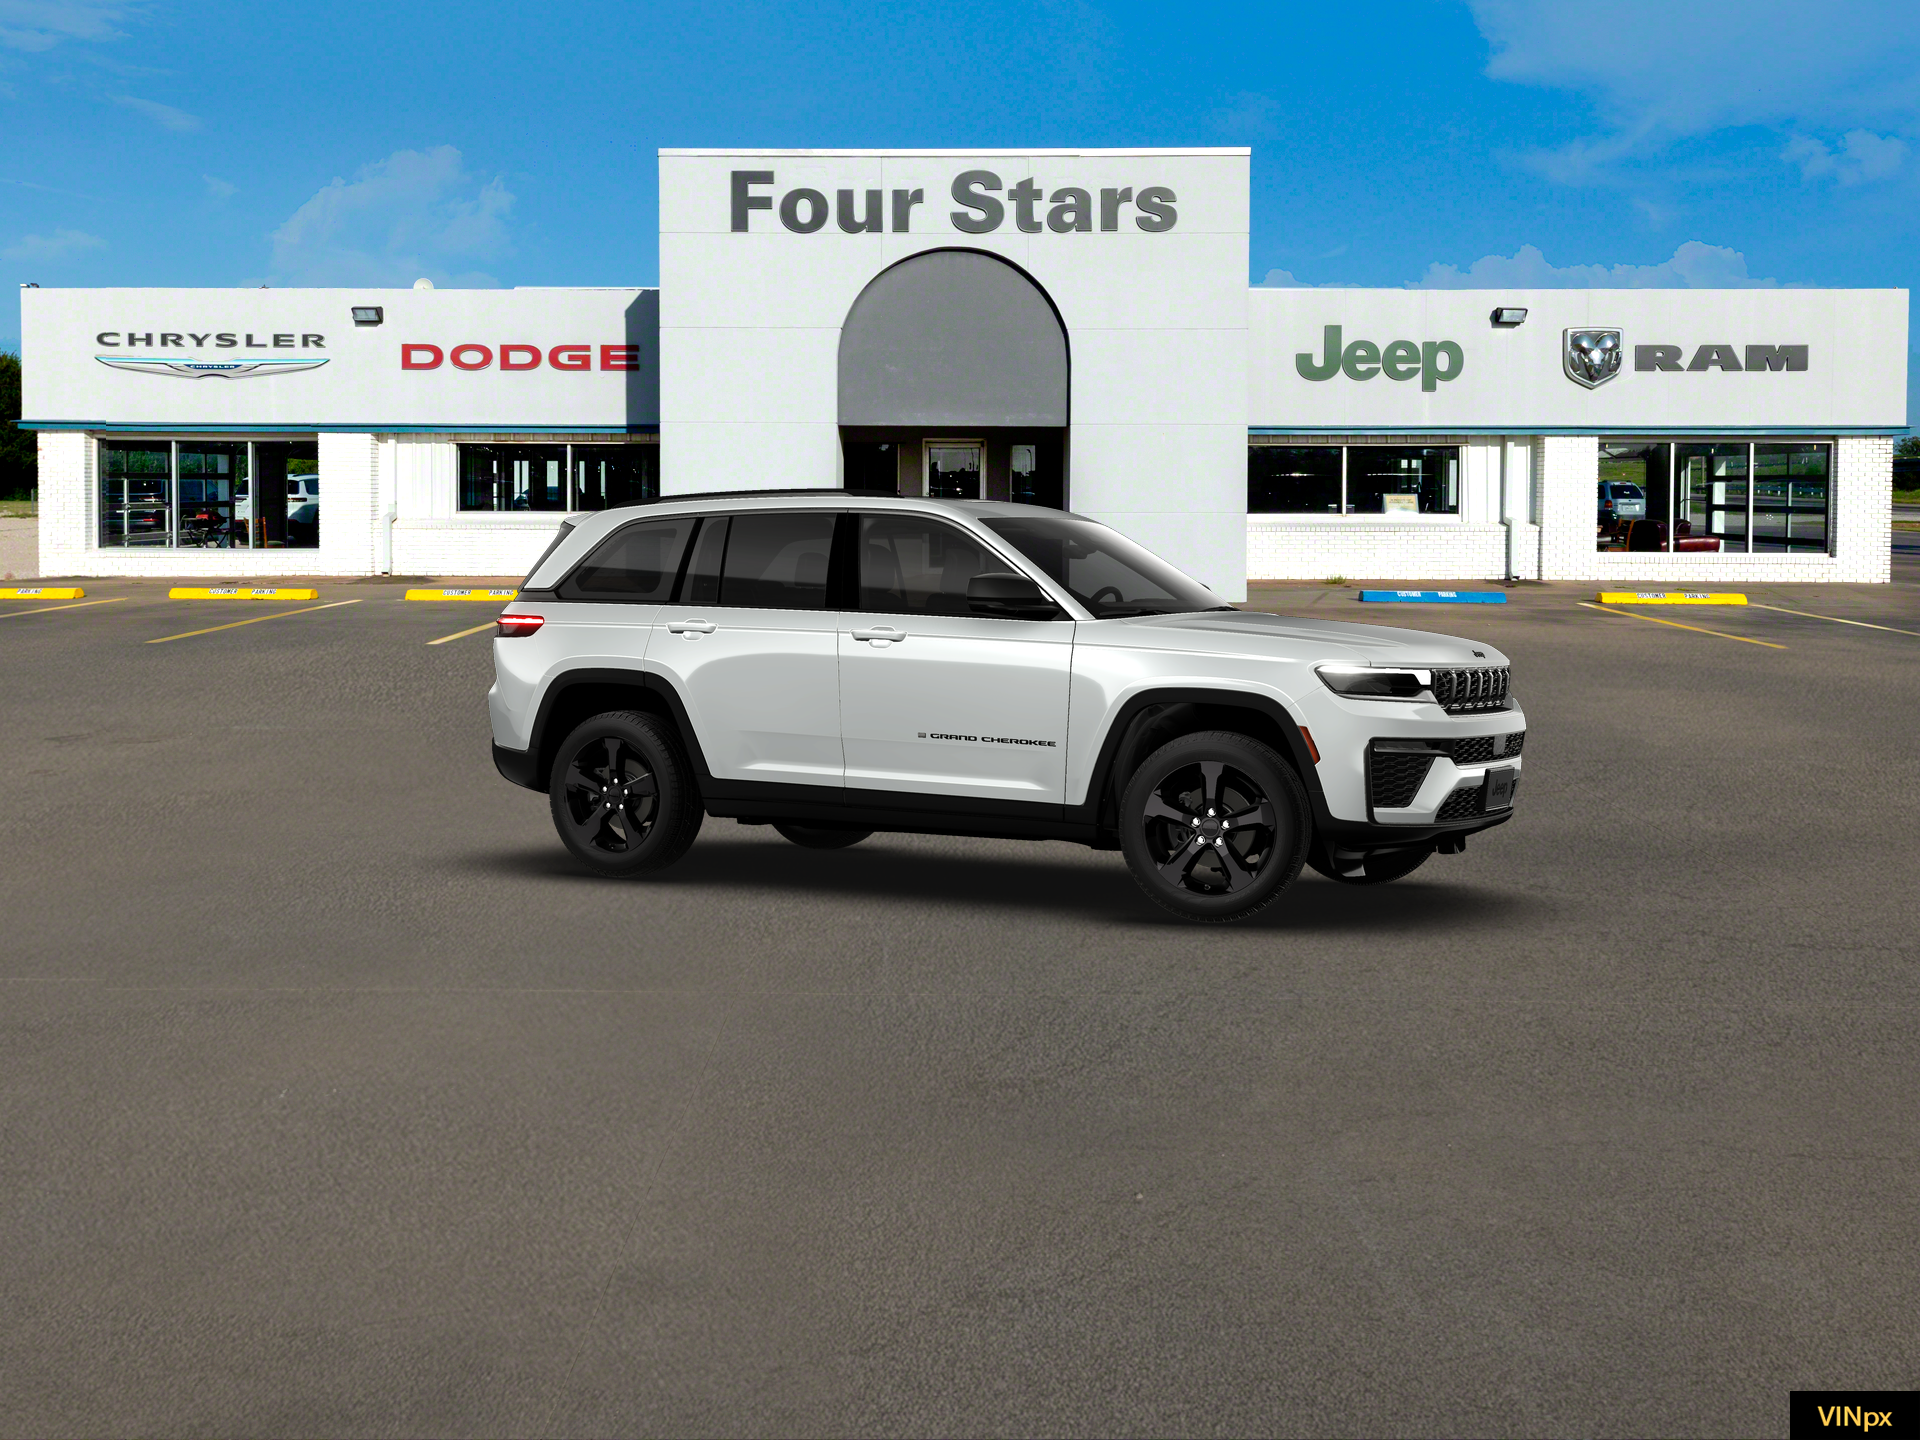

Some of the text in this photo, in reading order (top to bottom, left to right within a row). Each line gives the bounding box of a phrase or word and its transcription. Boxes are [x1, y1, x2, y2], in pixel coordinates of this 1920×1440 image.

[730, 169, 1178, 234] Four Stars
[96, 332, 326, 349] CHRYSLER
[401, 343, 640, 371] DODGE
[1296, 325, 1464, 392] Jeep
[1634, 344, 1809, 372] RAM
[930, 733, 1056, 747] GRAND CHEROKEE
[1491, 779, 1508, 798] Jeep
